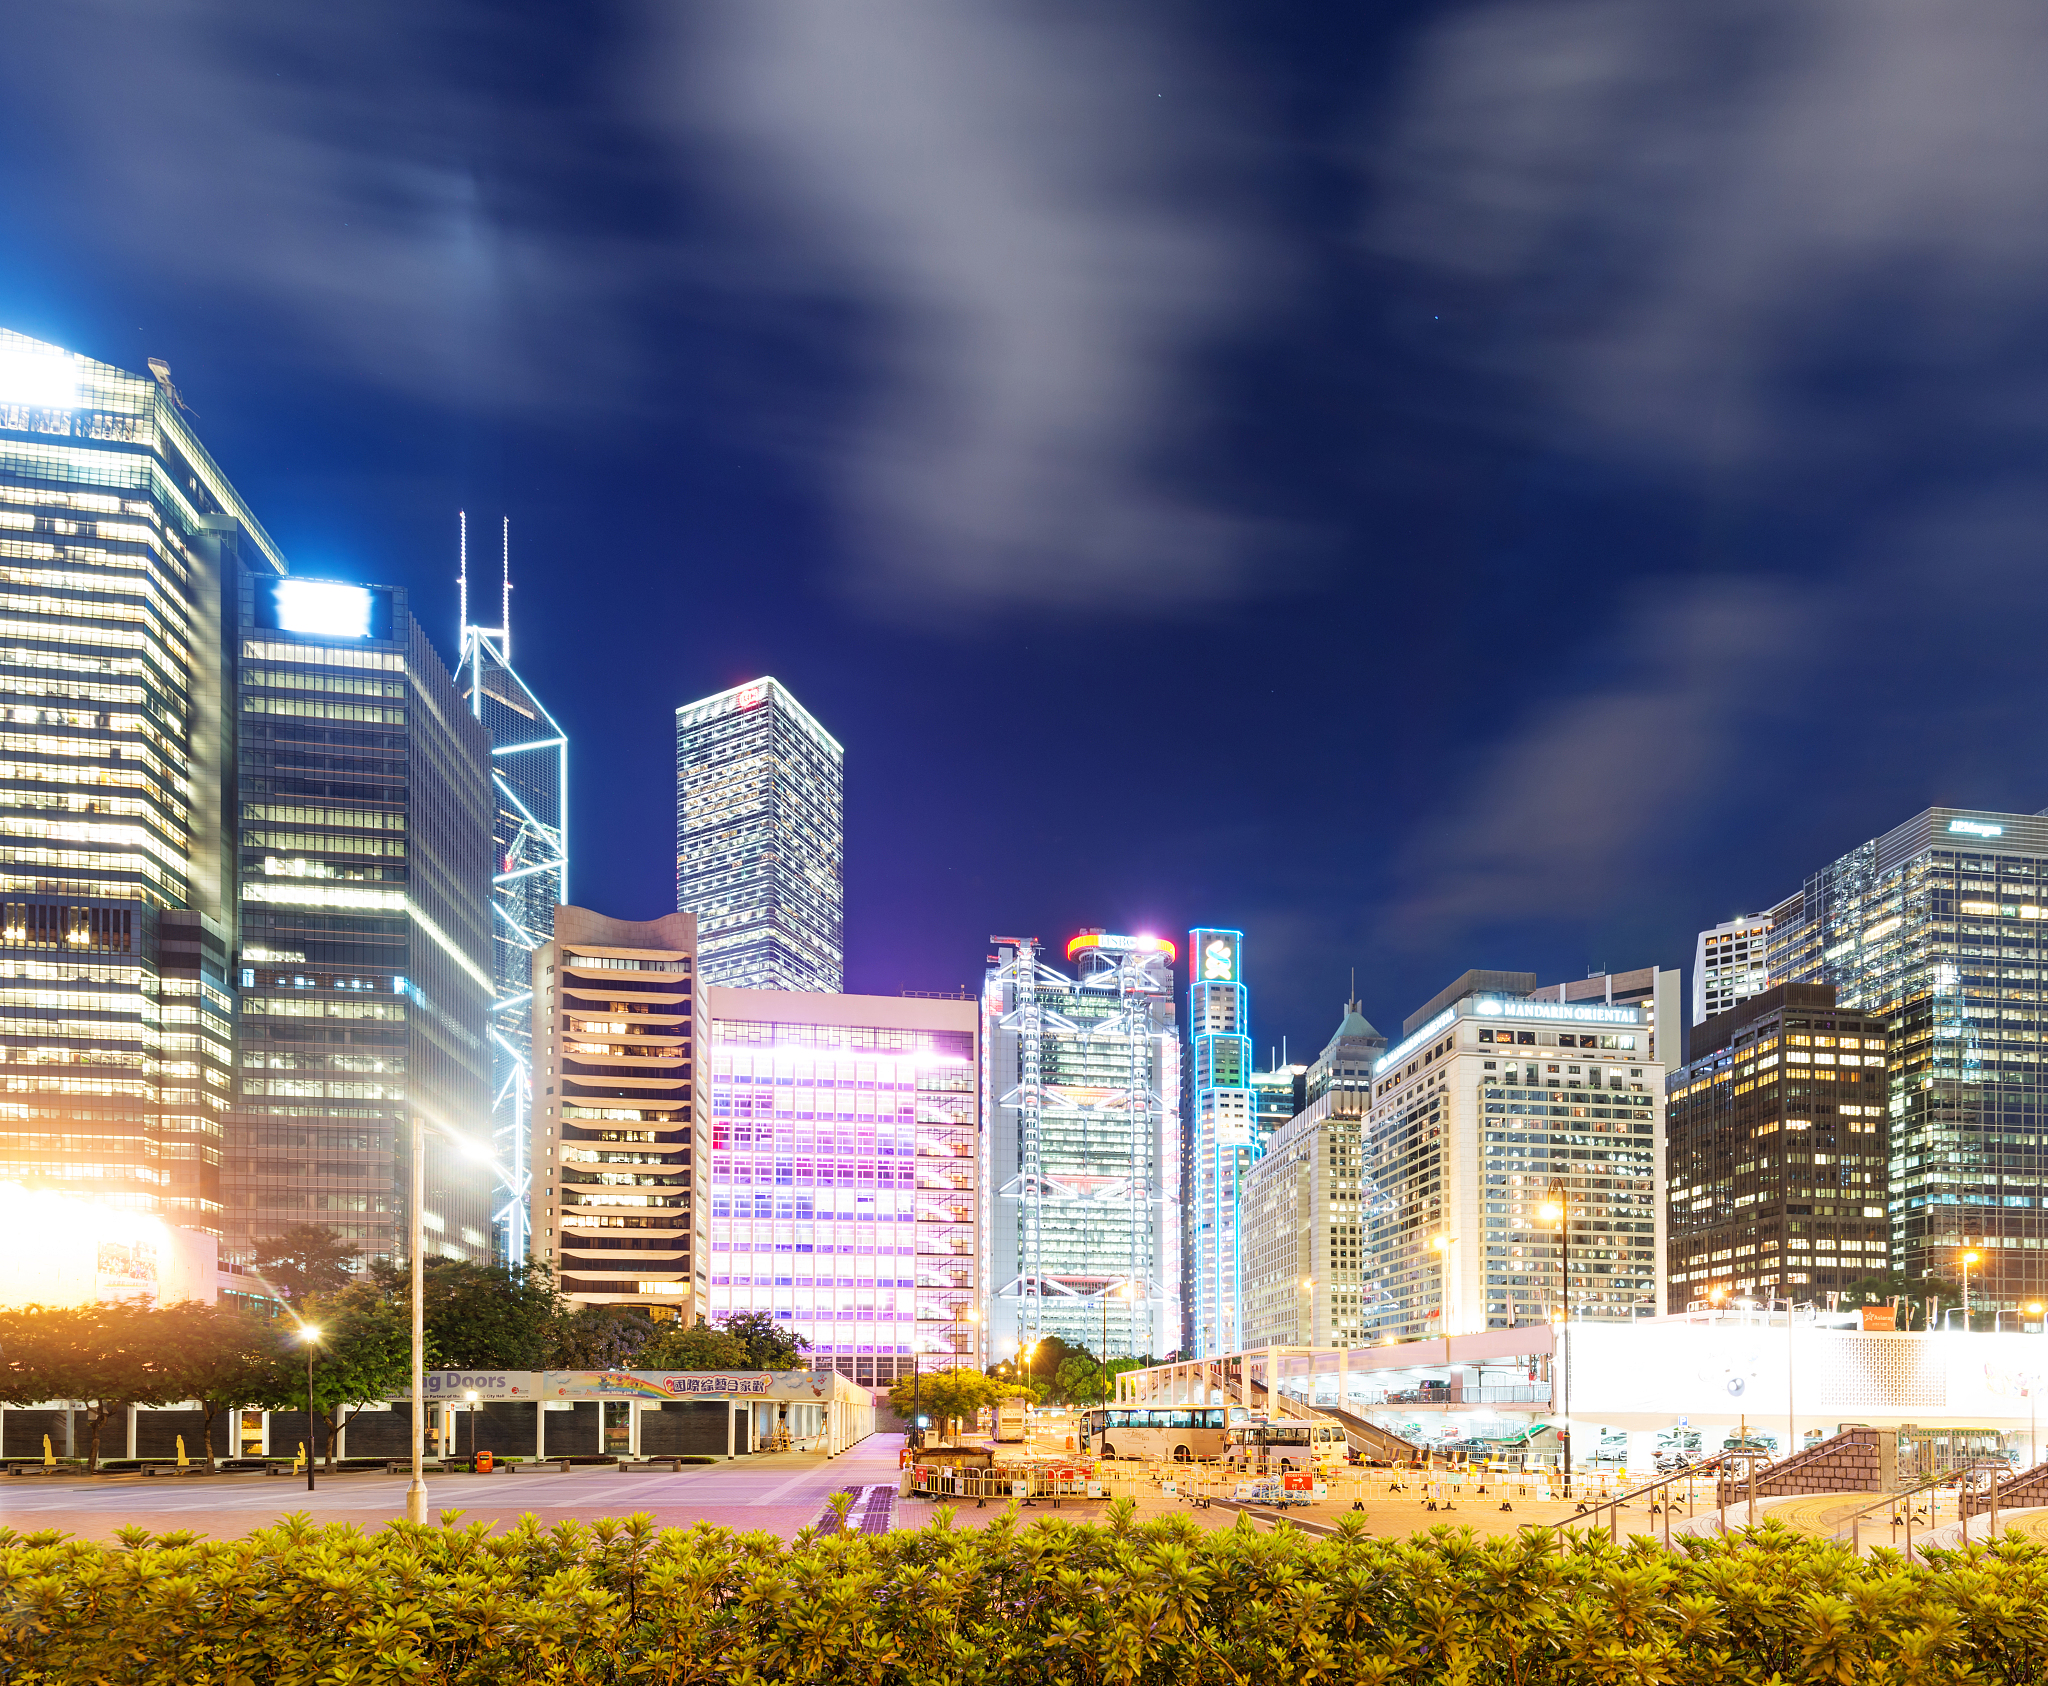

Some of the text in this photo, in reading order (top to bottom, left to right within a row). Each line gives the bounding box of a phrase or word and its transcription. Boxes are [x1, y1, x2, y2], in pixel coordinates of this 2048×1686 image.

[1100, 936, 1137, 949] HSBC
[1505, 1004, 1637, 1022] MANDARIN ORIENTAL
[446, 1372, 506, 1388] Doors
[673, 1378, 765, 1393] 國際綜藝合家歡
